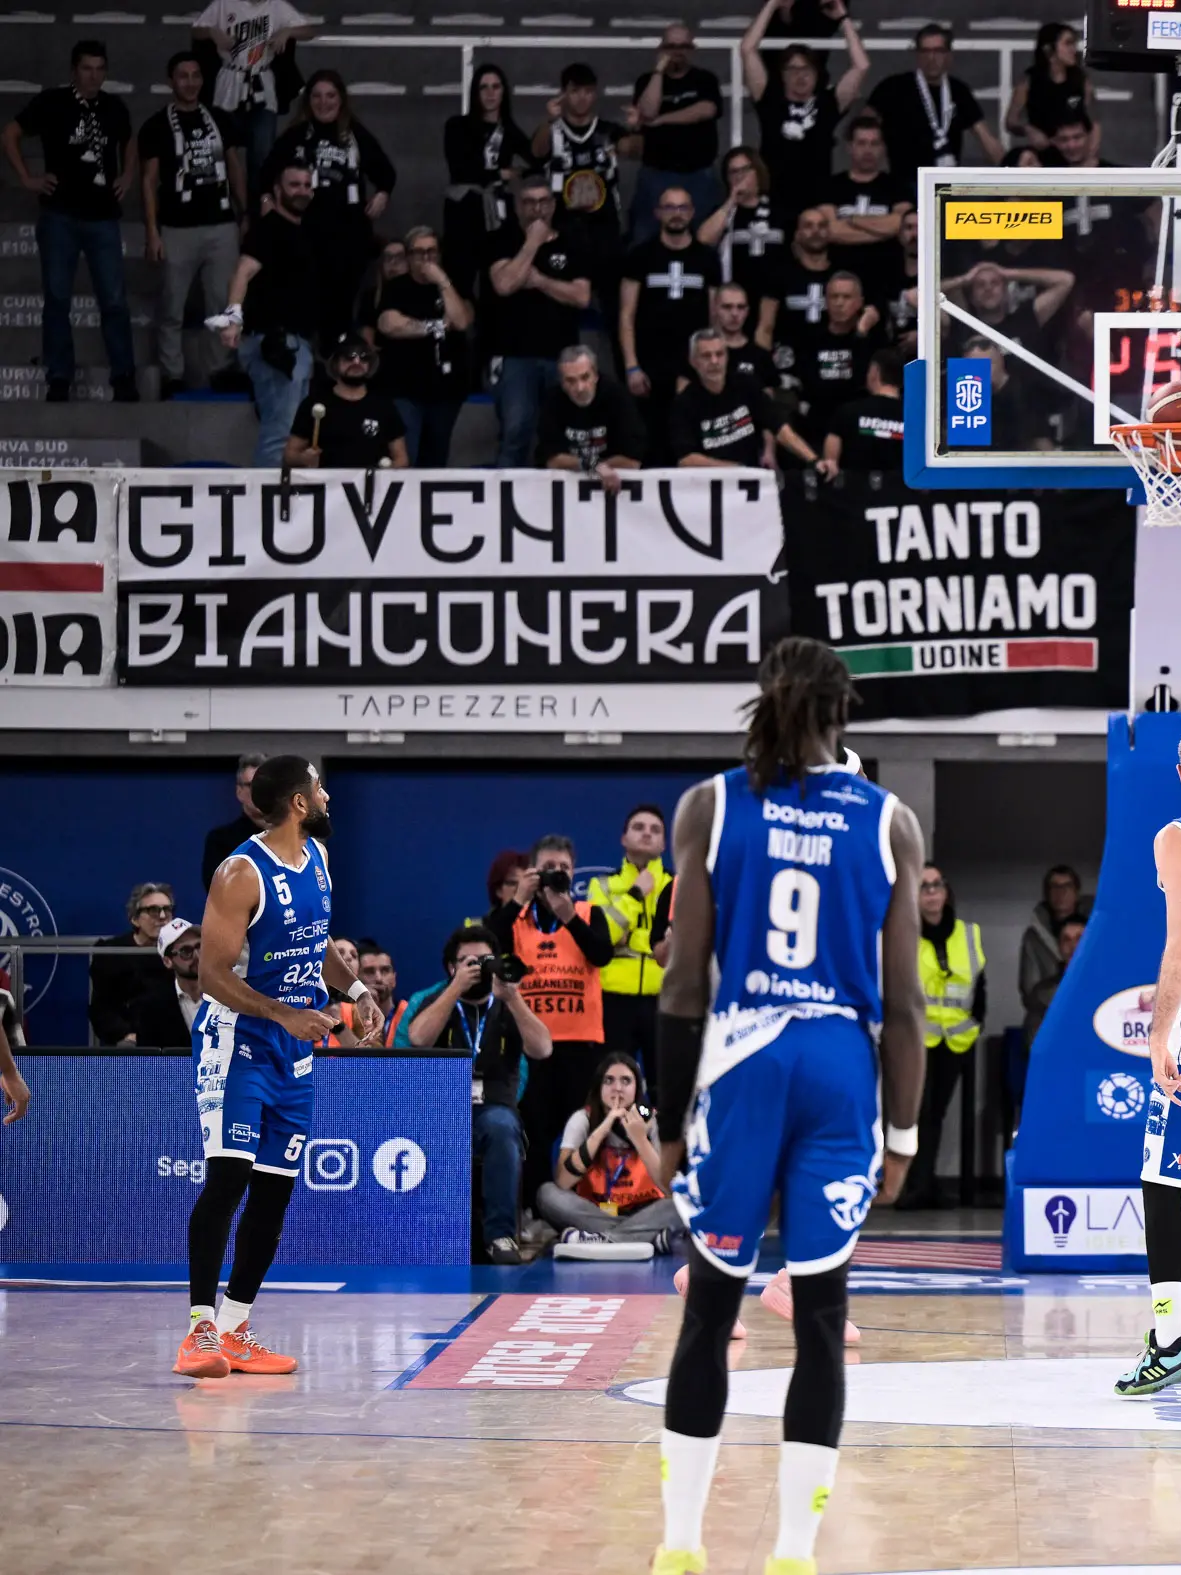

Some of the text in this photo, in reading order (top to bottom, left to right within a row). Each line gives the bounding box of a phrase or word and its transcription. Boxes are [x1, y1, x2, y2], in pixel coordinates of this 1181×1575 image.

[955, 212, 1052, 226] FASTWEB
[951, 415, 987, 429] FIP
[865, 500, 1041, 563] TANTO
[815, 573, 1097, 639] TORNIAMO
[127, 589, 761, 667] BIANCONERA
[920, 643, 1002, 669] UDINE
[338, 695, 609, 718] TAPPEZZERIA
[272, 872, 293, 906] 5
[766, 868, 821, 970] 9
[284, 1134, 306, 1162] 5
[157, 1155, 208, 1185] Seg
